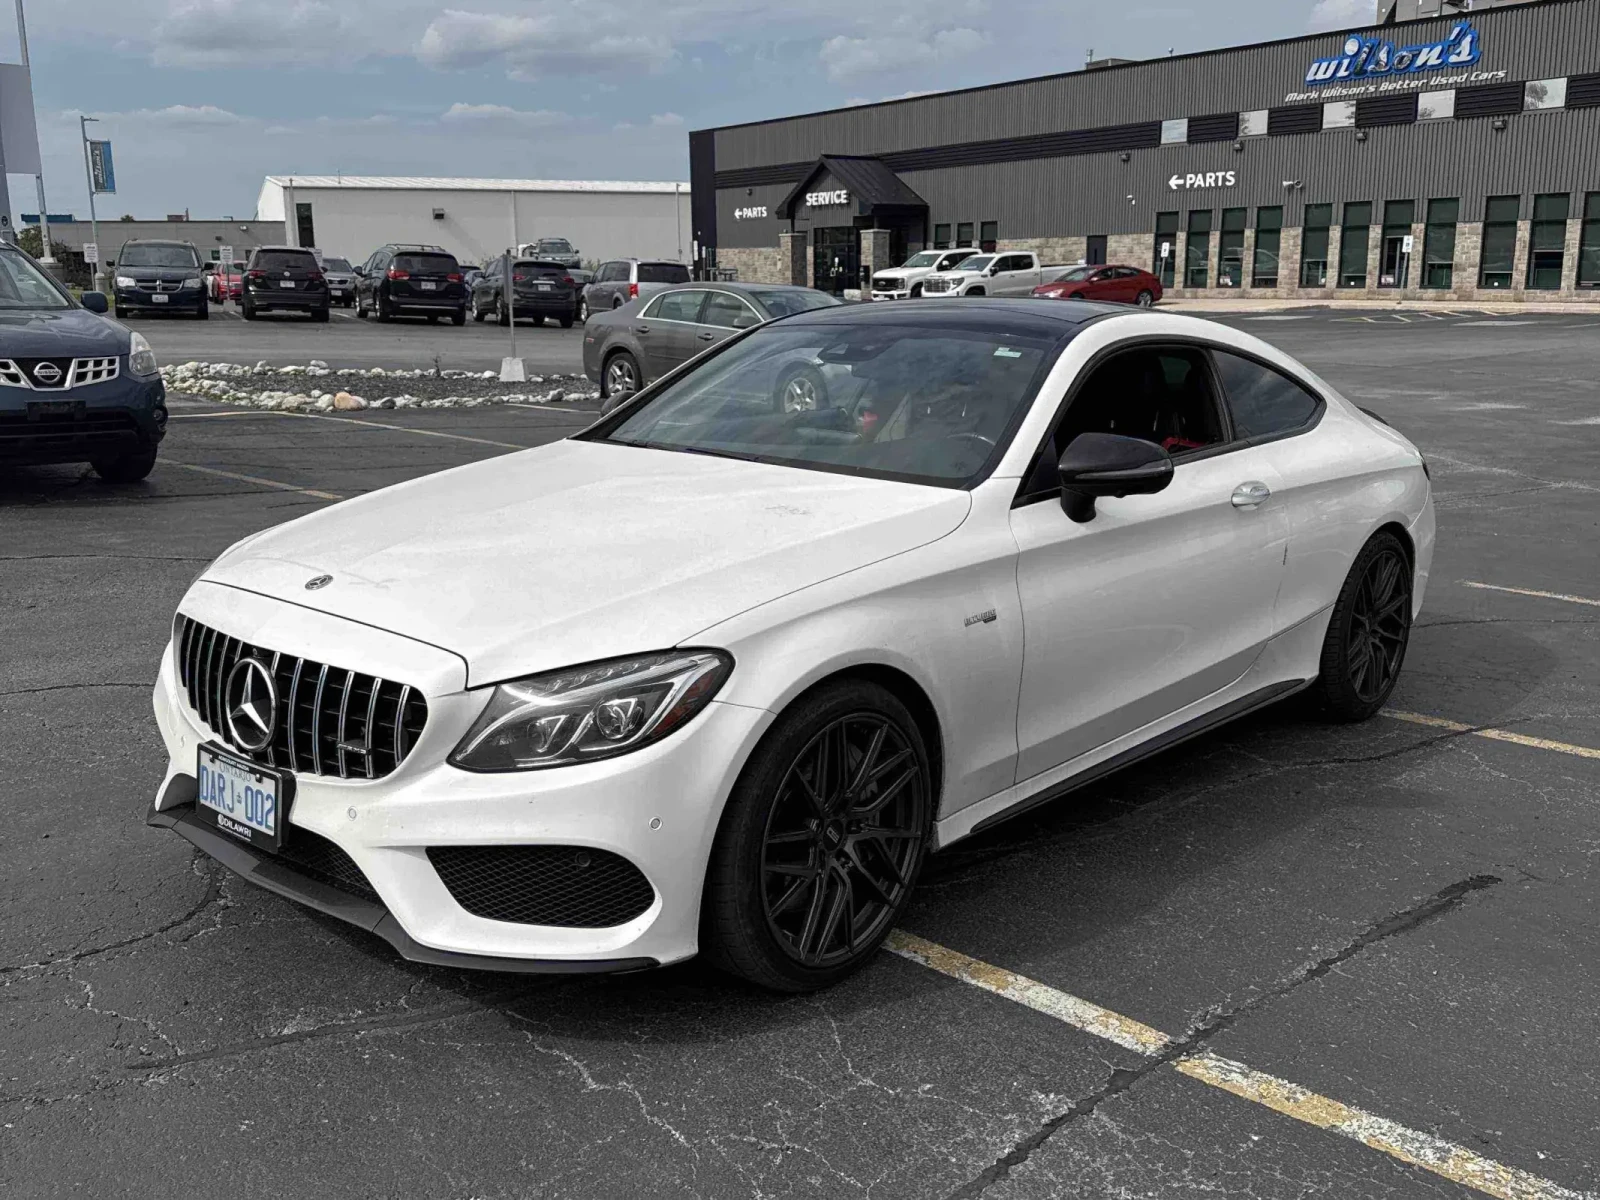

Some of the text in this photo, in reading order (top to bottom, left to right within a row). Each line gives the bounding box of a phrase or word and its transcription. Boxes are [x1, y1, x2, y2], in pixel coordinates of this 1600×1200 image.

[1306, 26, 1473, 82] wilson's
[1285, 69, 1508, 102] Mark Wilson's Better Used Cars
[1185, 171, 1236, 189] PARTS
[805, 189, 848, 207] SERVICE
[742, 206, 767, 219] PARTS
[200, 764, 274, 831] DARJ 002
